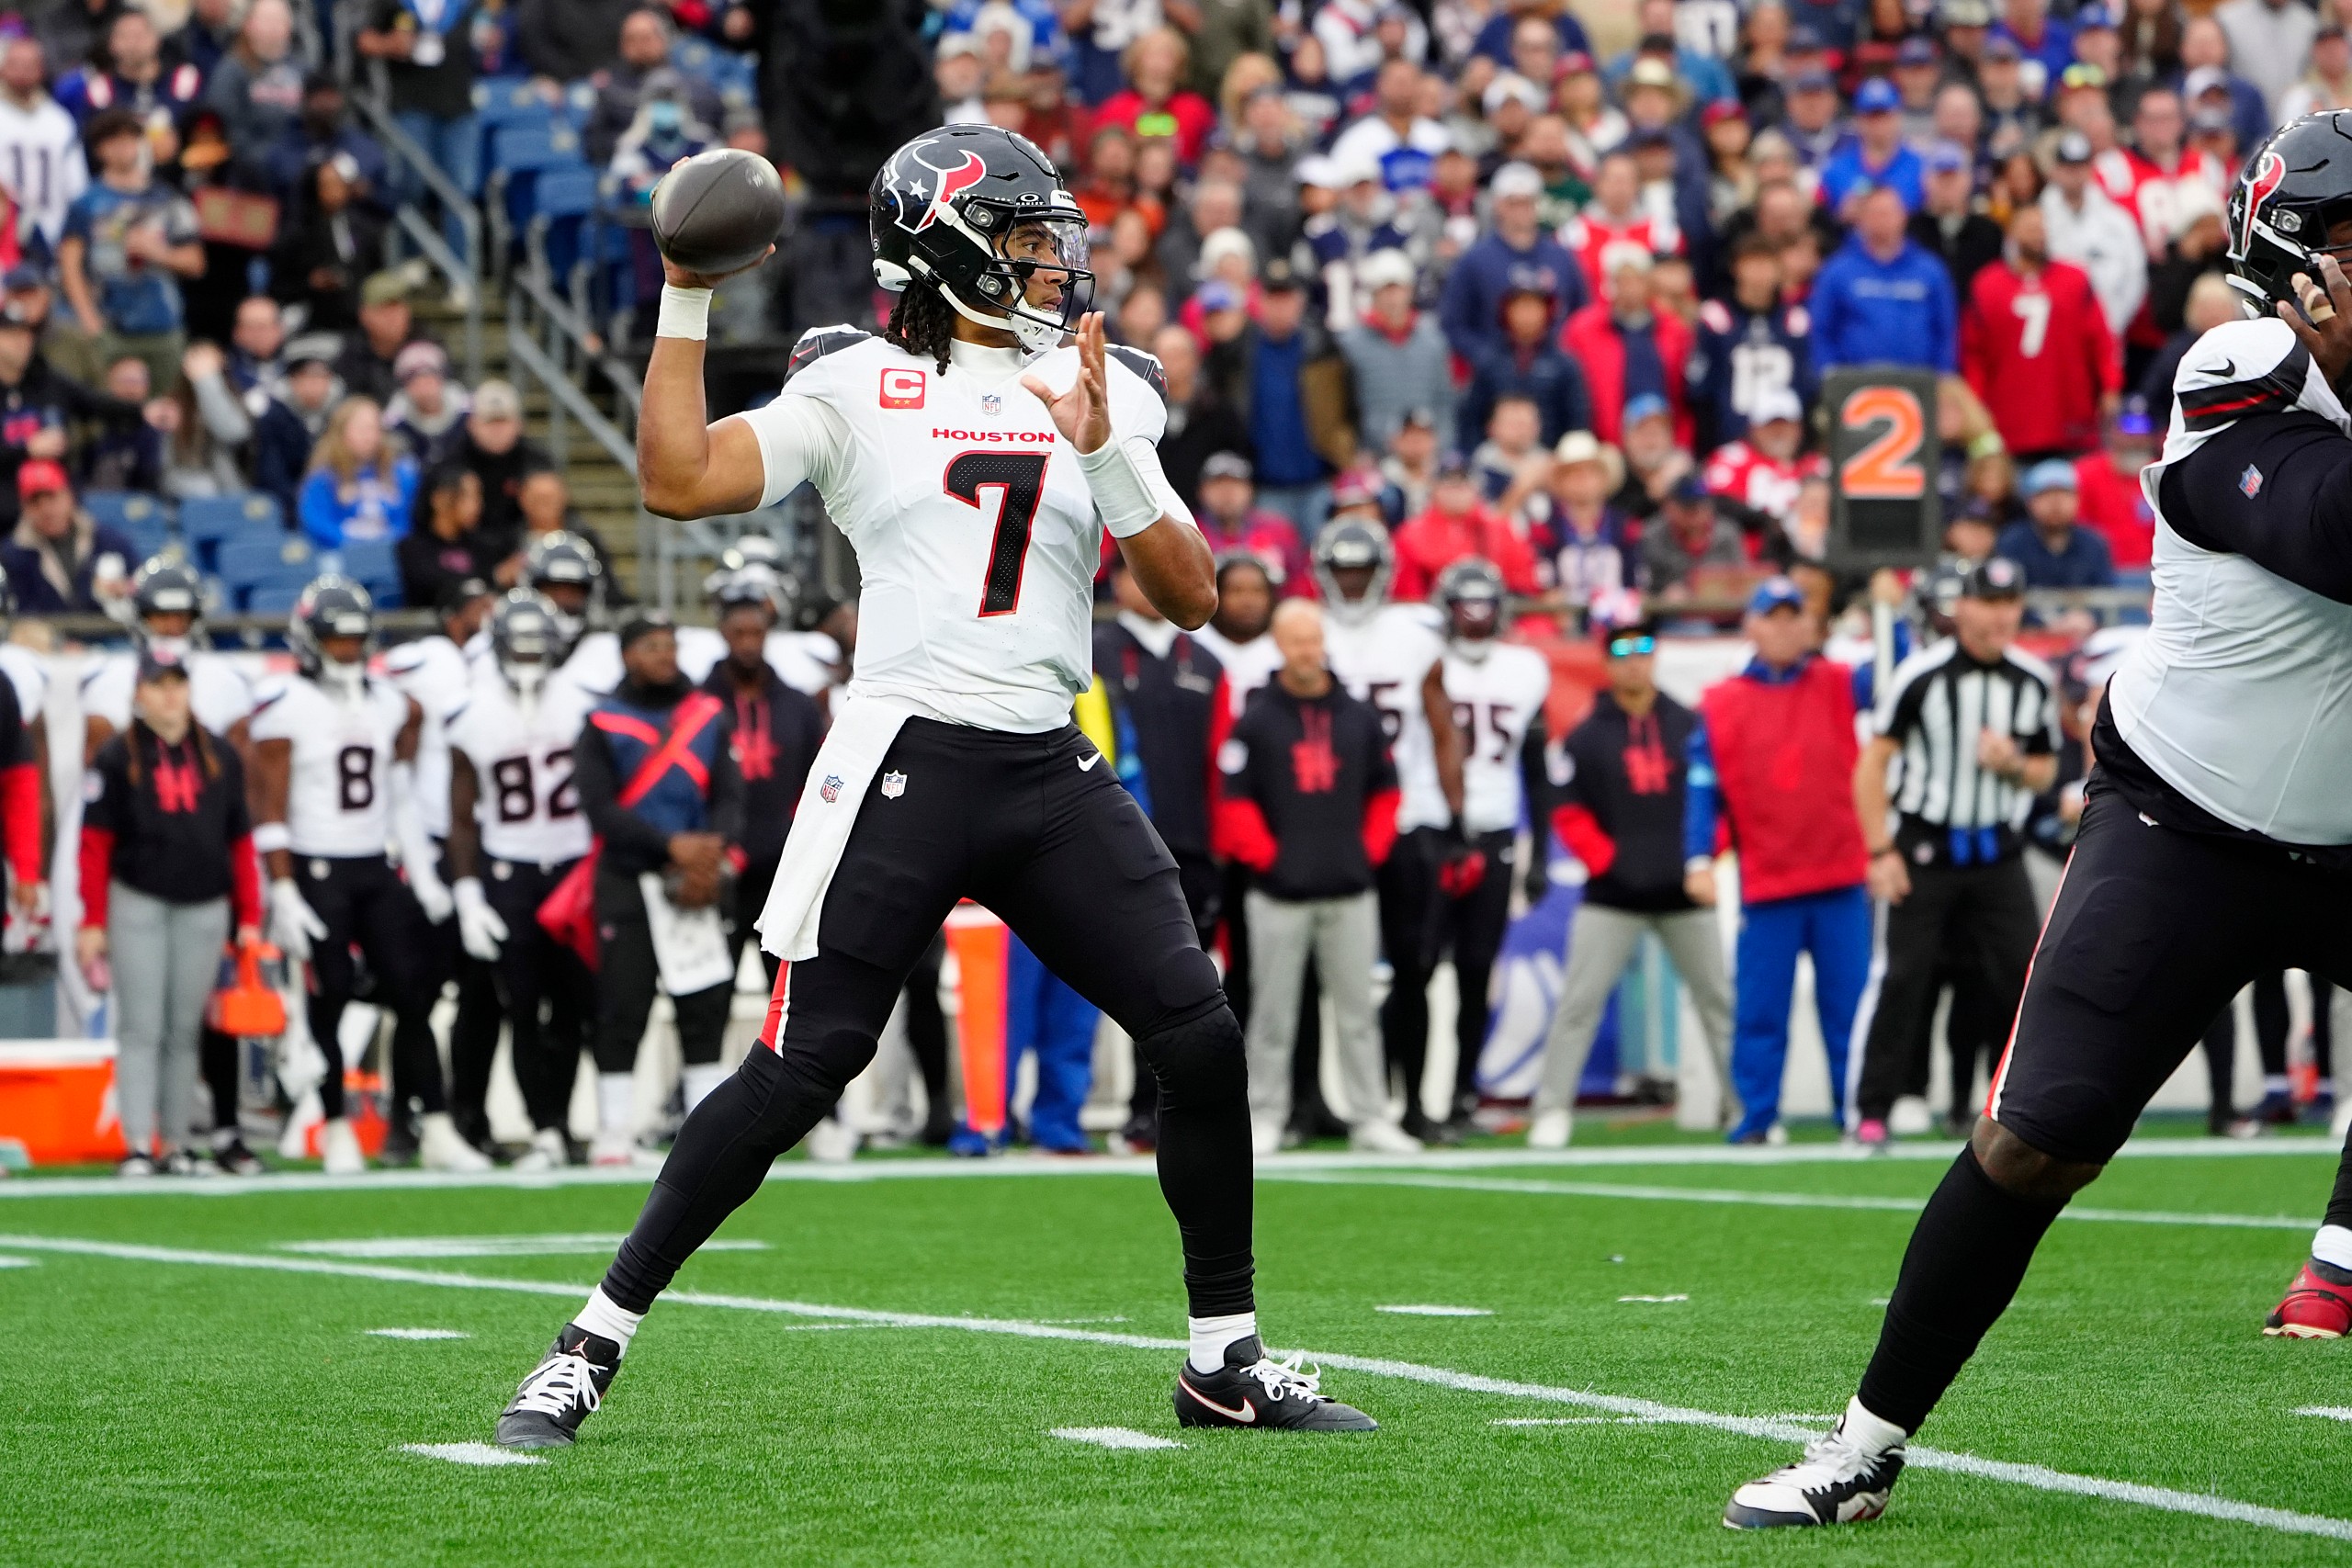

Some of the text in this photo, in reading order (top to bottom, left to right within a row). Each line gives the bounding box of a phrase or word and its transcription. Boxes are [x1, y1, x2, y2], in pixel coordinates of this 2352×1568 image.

[2011, 294, 2051, 358] 7
[883, 370, 923, 399] C
[932, 428, 1055, 444] HOUSTON
[1841, 384, 1925, 498] 2
[943, 449, 1052, 618] 7
[339, 745, 375, 810] 8
[492, 749, 581, 822] 82
[822, 784, 837, 801] NFL
